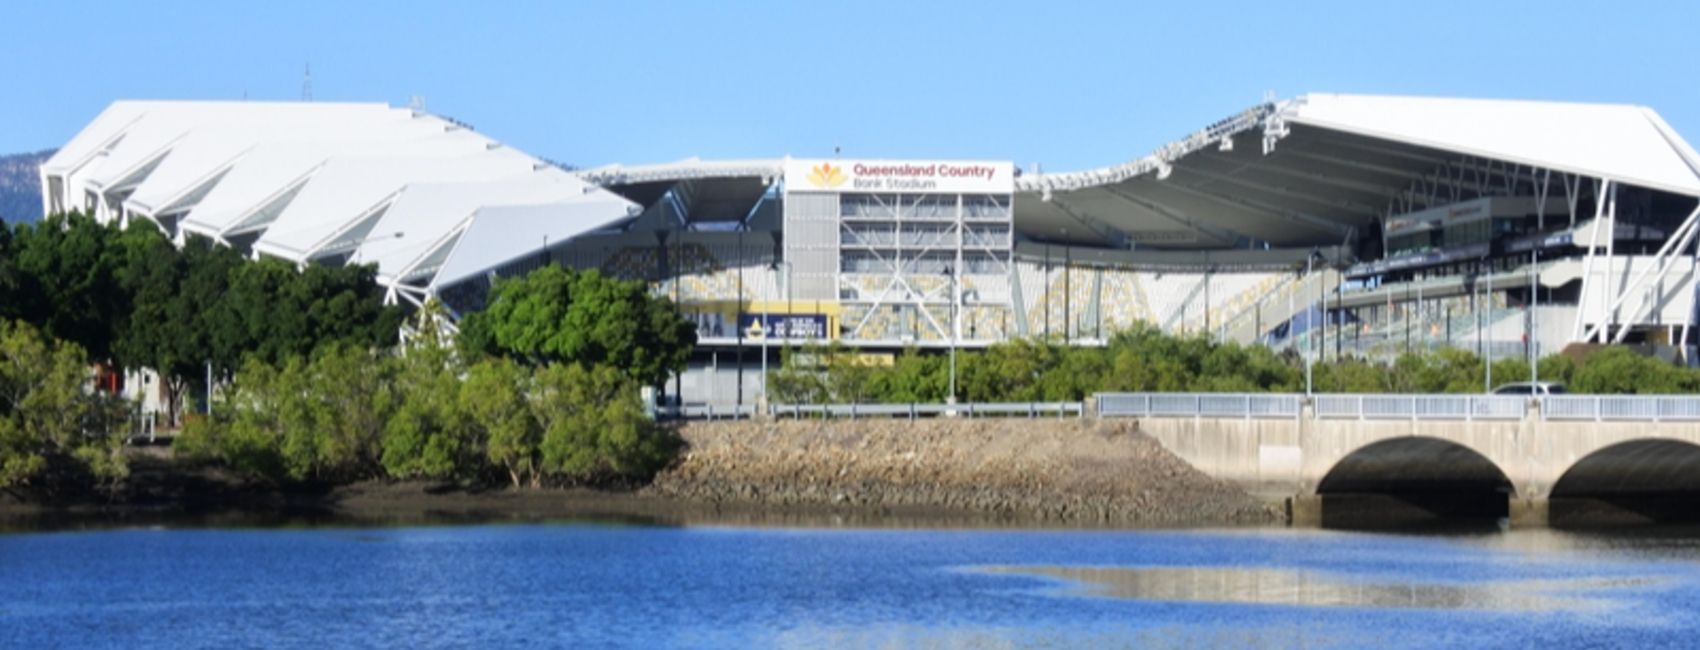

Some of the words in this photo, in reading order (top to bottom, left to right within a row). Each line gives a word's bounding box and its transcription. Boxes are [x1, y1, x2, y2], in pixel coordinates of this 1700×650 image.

[853, 163, 936, 177] Queensland
[938, 164, 995, 180] Country
[853, 178, 883, 189] Bank
[886, 178, 936, 189] Stadium
